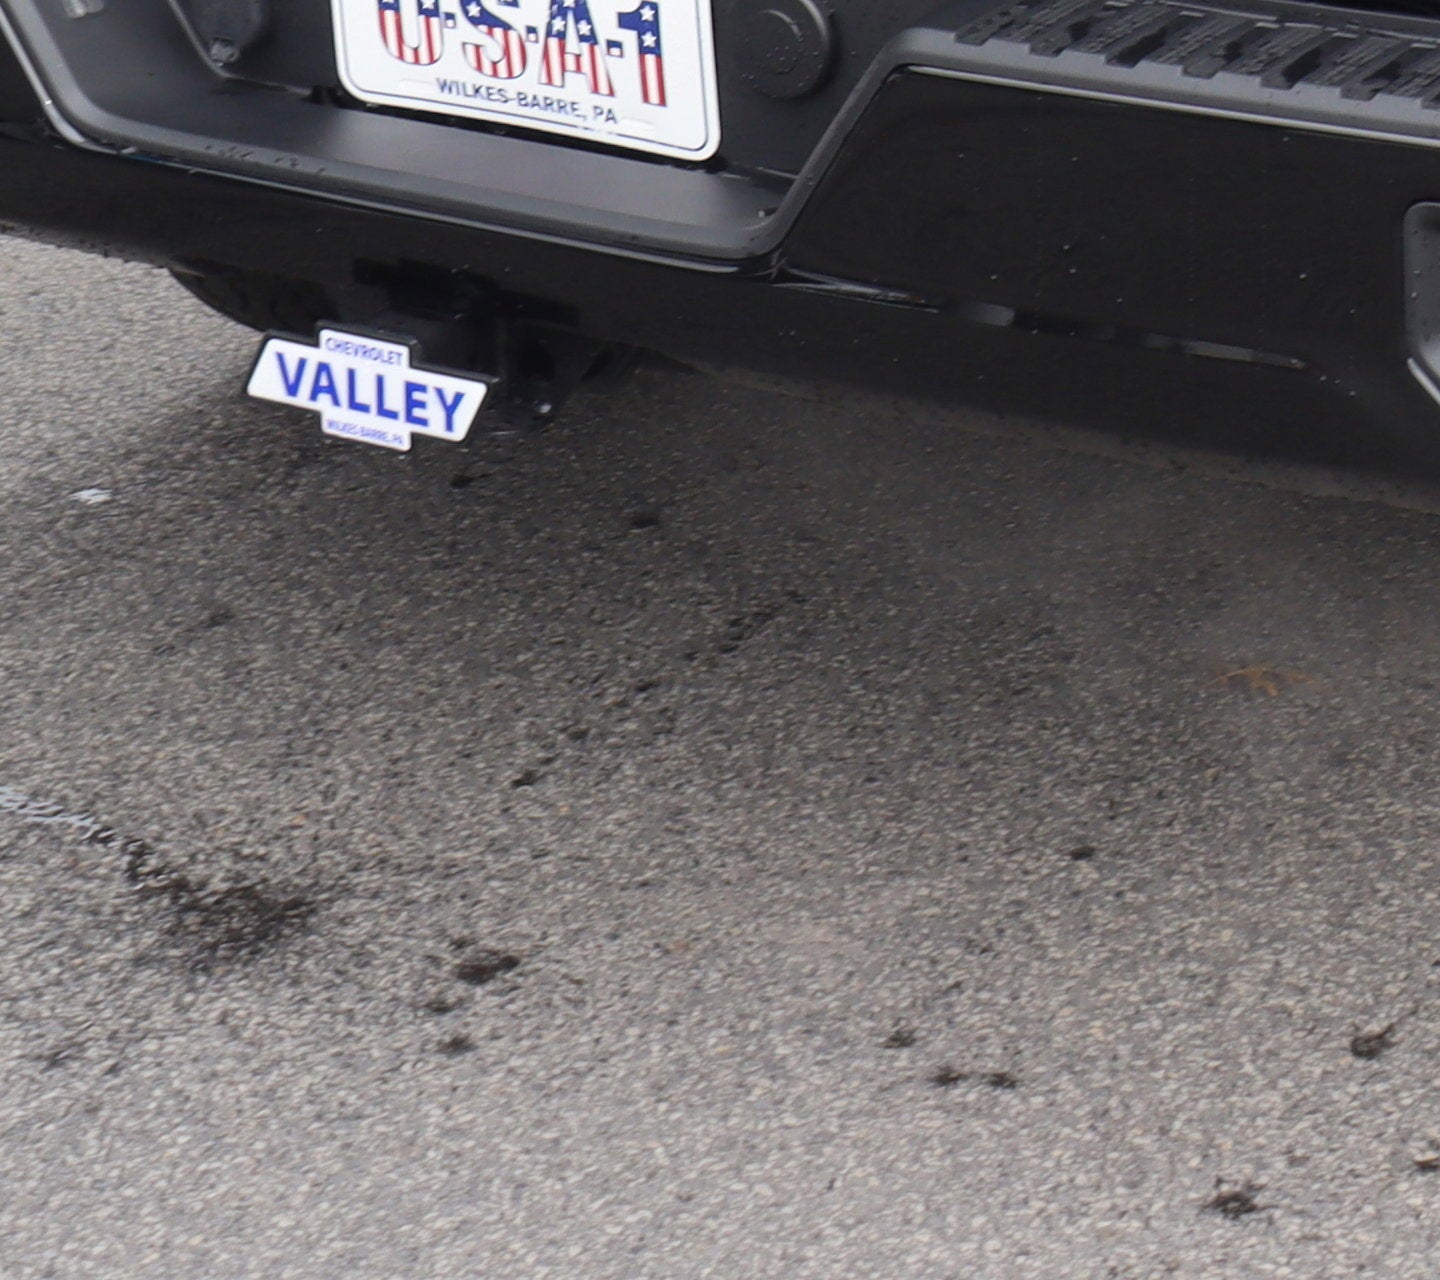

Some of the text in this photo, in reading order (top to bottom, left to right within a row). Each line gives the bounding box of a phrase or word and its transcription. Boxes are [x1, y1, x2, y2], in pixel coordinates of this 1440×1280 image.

[436, 76, 618, 125] WILKES-BARRE, PA
[325, 337, 403, 366] CHEVROLET
[275, 351, 465, 433] VALLEY
